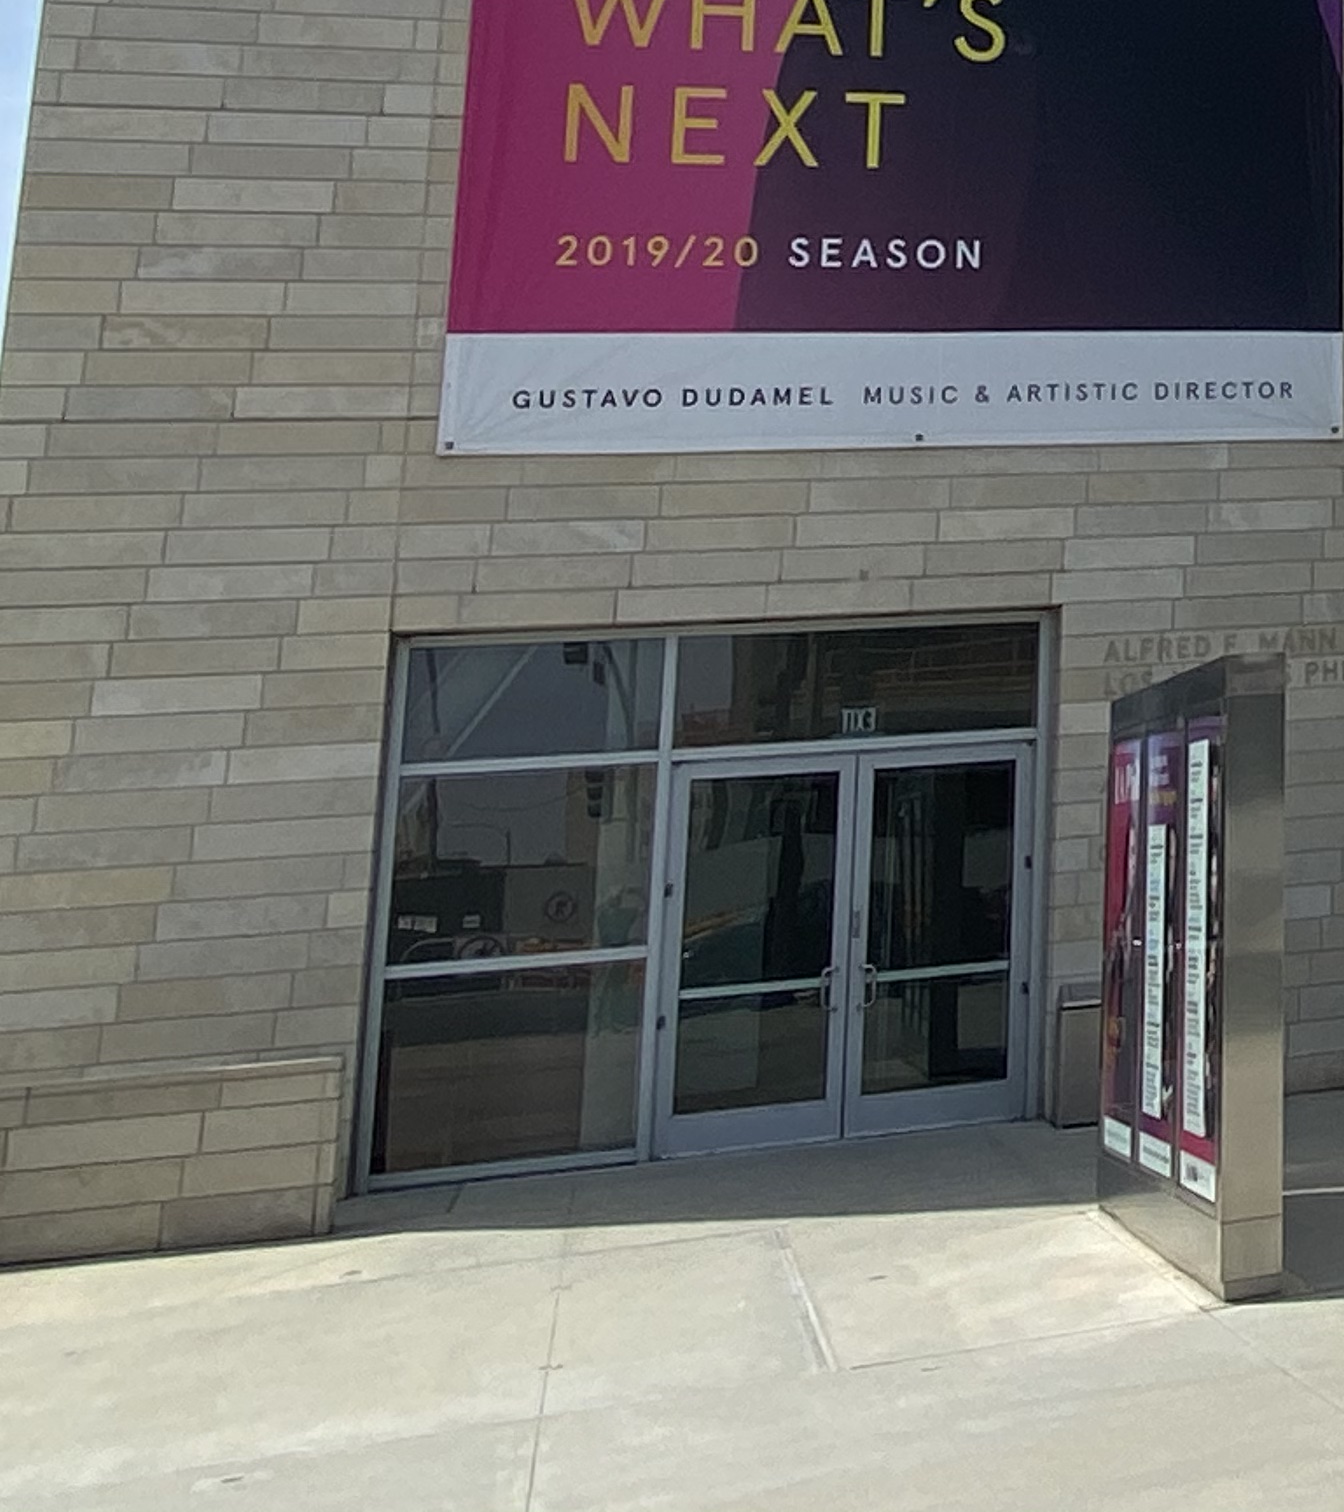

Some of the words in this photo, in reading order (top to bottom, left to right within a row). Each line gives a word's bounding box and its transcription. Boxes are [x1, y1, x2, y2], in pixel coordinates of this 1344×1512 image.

[563, 83, 907, 169] NEXT
[555, 235, 759, 268] 2019/20
[788, 236, 983, 270] SEASON
[512, 387, 663, 410] GUSTAVO
[682, 387, 834, 407] DUDAMEL
[863, 385, 959, 405] MUSIC
[974, 385, 991, 404] &
[1006, 382, 1139, 403] ARTISTIC
[1154, 381, 1294, 401] DIRECTOR
[1103, 634, 1211, 663] ALFRED
[1258, 627, 1338, 653] MANN
